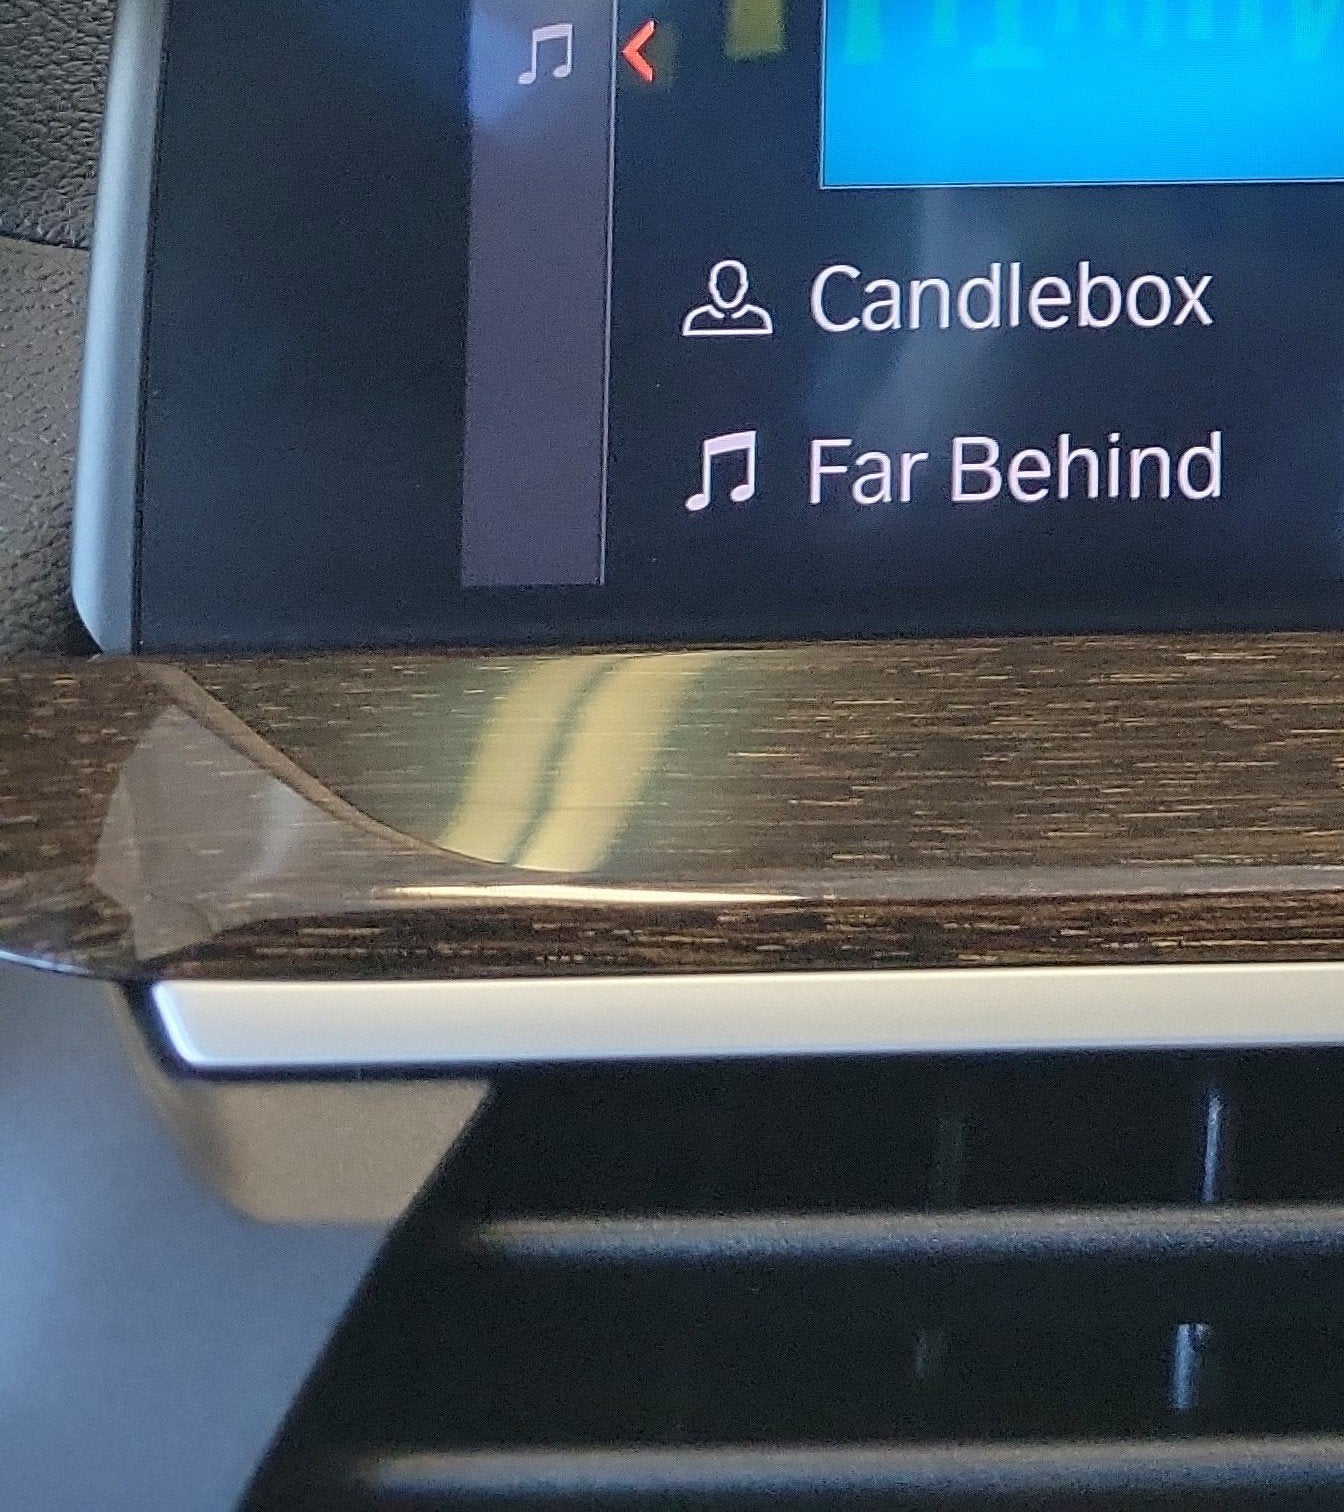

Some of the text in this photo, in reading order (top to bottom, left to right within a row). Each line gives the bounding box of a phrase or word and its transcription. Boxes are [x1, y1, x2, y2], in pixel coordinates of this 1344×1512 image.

[810, 260, 1214, 333] Candlebox
[809, 429, 1222, 506] Far Behind
